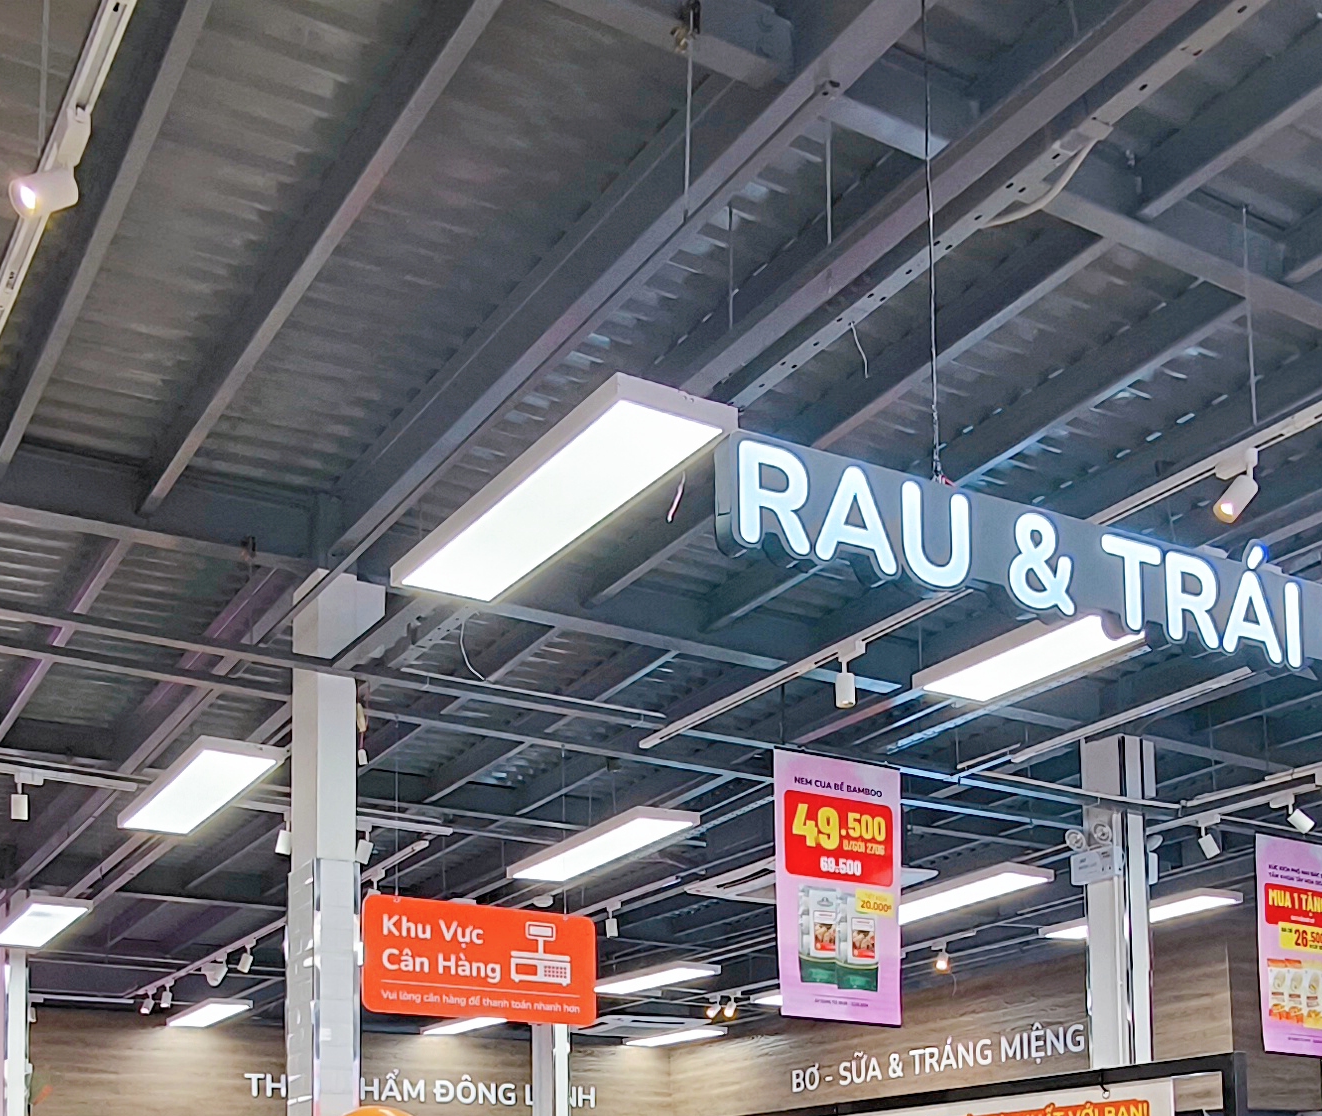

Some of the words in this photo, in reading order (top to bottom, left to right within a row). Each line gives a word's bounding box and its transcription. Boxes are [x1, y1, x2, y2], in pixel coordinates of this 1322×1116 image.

[735, 437, 973, 589] RAU
[1007, 511, 1076, 617] &
[1099, 534, 1303, 670] TRÁI
[794, 776, 813, 787] NEM
[814, 778, 832, 790] CUA
[846, 784, 883, 798] BAMBOO
[1268, 888, 1292, 909] MUA
[1293, 892, 1300, 910] 1
[382, 913, 432, 940] Khu
[439, 919, 485, 949] Vực
[381, 947, 430, 973] Cân
[437, 952, 502, 984] Hàng
[381, 990, 397, 1000] Vui
[399, 990, 421, 1003] lòng
[423, 991, 440, 1002] cân
[442, 994, 467, 1007] hàng
[482, 998, 510, 1009] thanh
[533, 1001, 566, 1013] nhanh
[567, 1003, 581, 1014] hơn
[791, 1061, 821, 1093] BƠ
[838, 1050, 883, 1086] SỮA
[888, 1052, 904, 1079] &
[908, 1035, 993, 1075] TRÁNG
[999, 1021, 1085, 1065] MIỆNG
[244, 1072, 287, 1099] TH
[359, 1068, 426, 1102] HẨM
[432, 1073, 517, 1107] ĐÔNG
[525, 1084, 597, 1109] LNH
